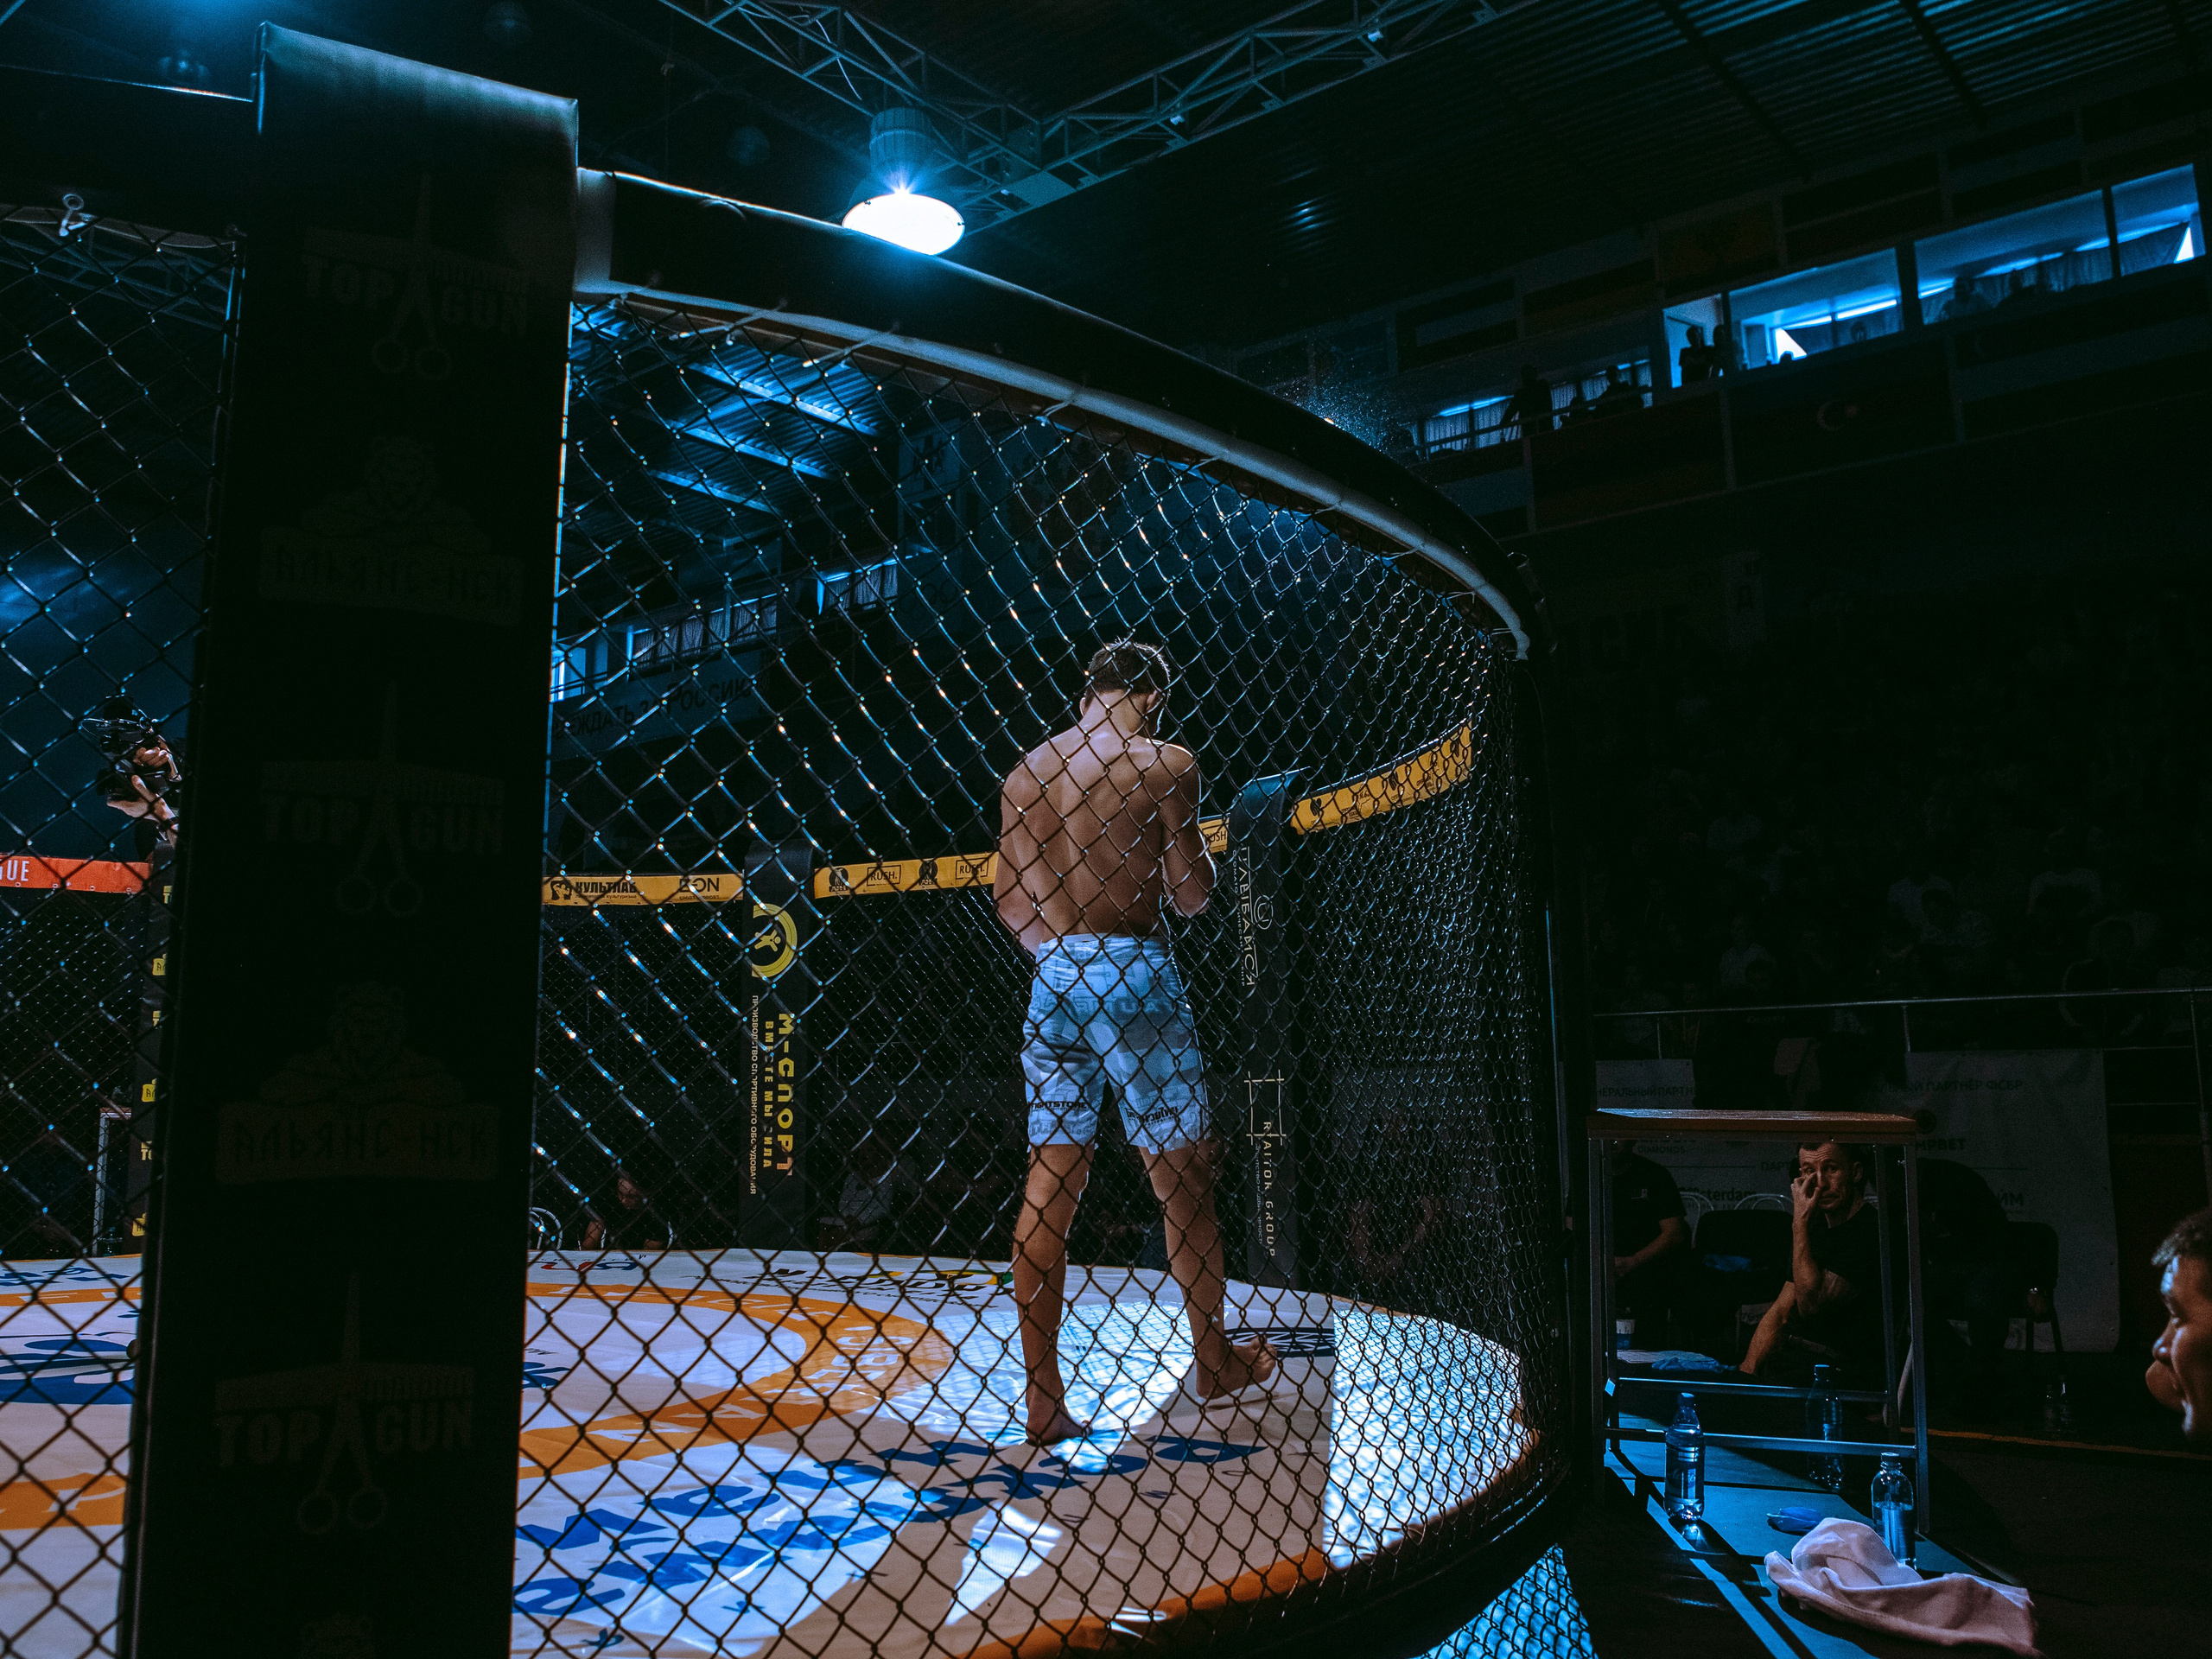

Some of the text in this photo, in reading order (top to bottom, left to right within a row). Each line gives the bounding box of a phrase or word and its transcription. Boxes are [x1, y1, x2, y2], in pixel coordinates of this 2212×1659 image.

[301, 254, 529, 338] TOP GUN
[261, 794, 505, 855] TOP GUN
[764, 1090, 774, 1117] МЫ
[213, 1400, 472, 1469] TOP GUN
